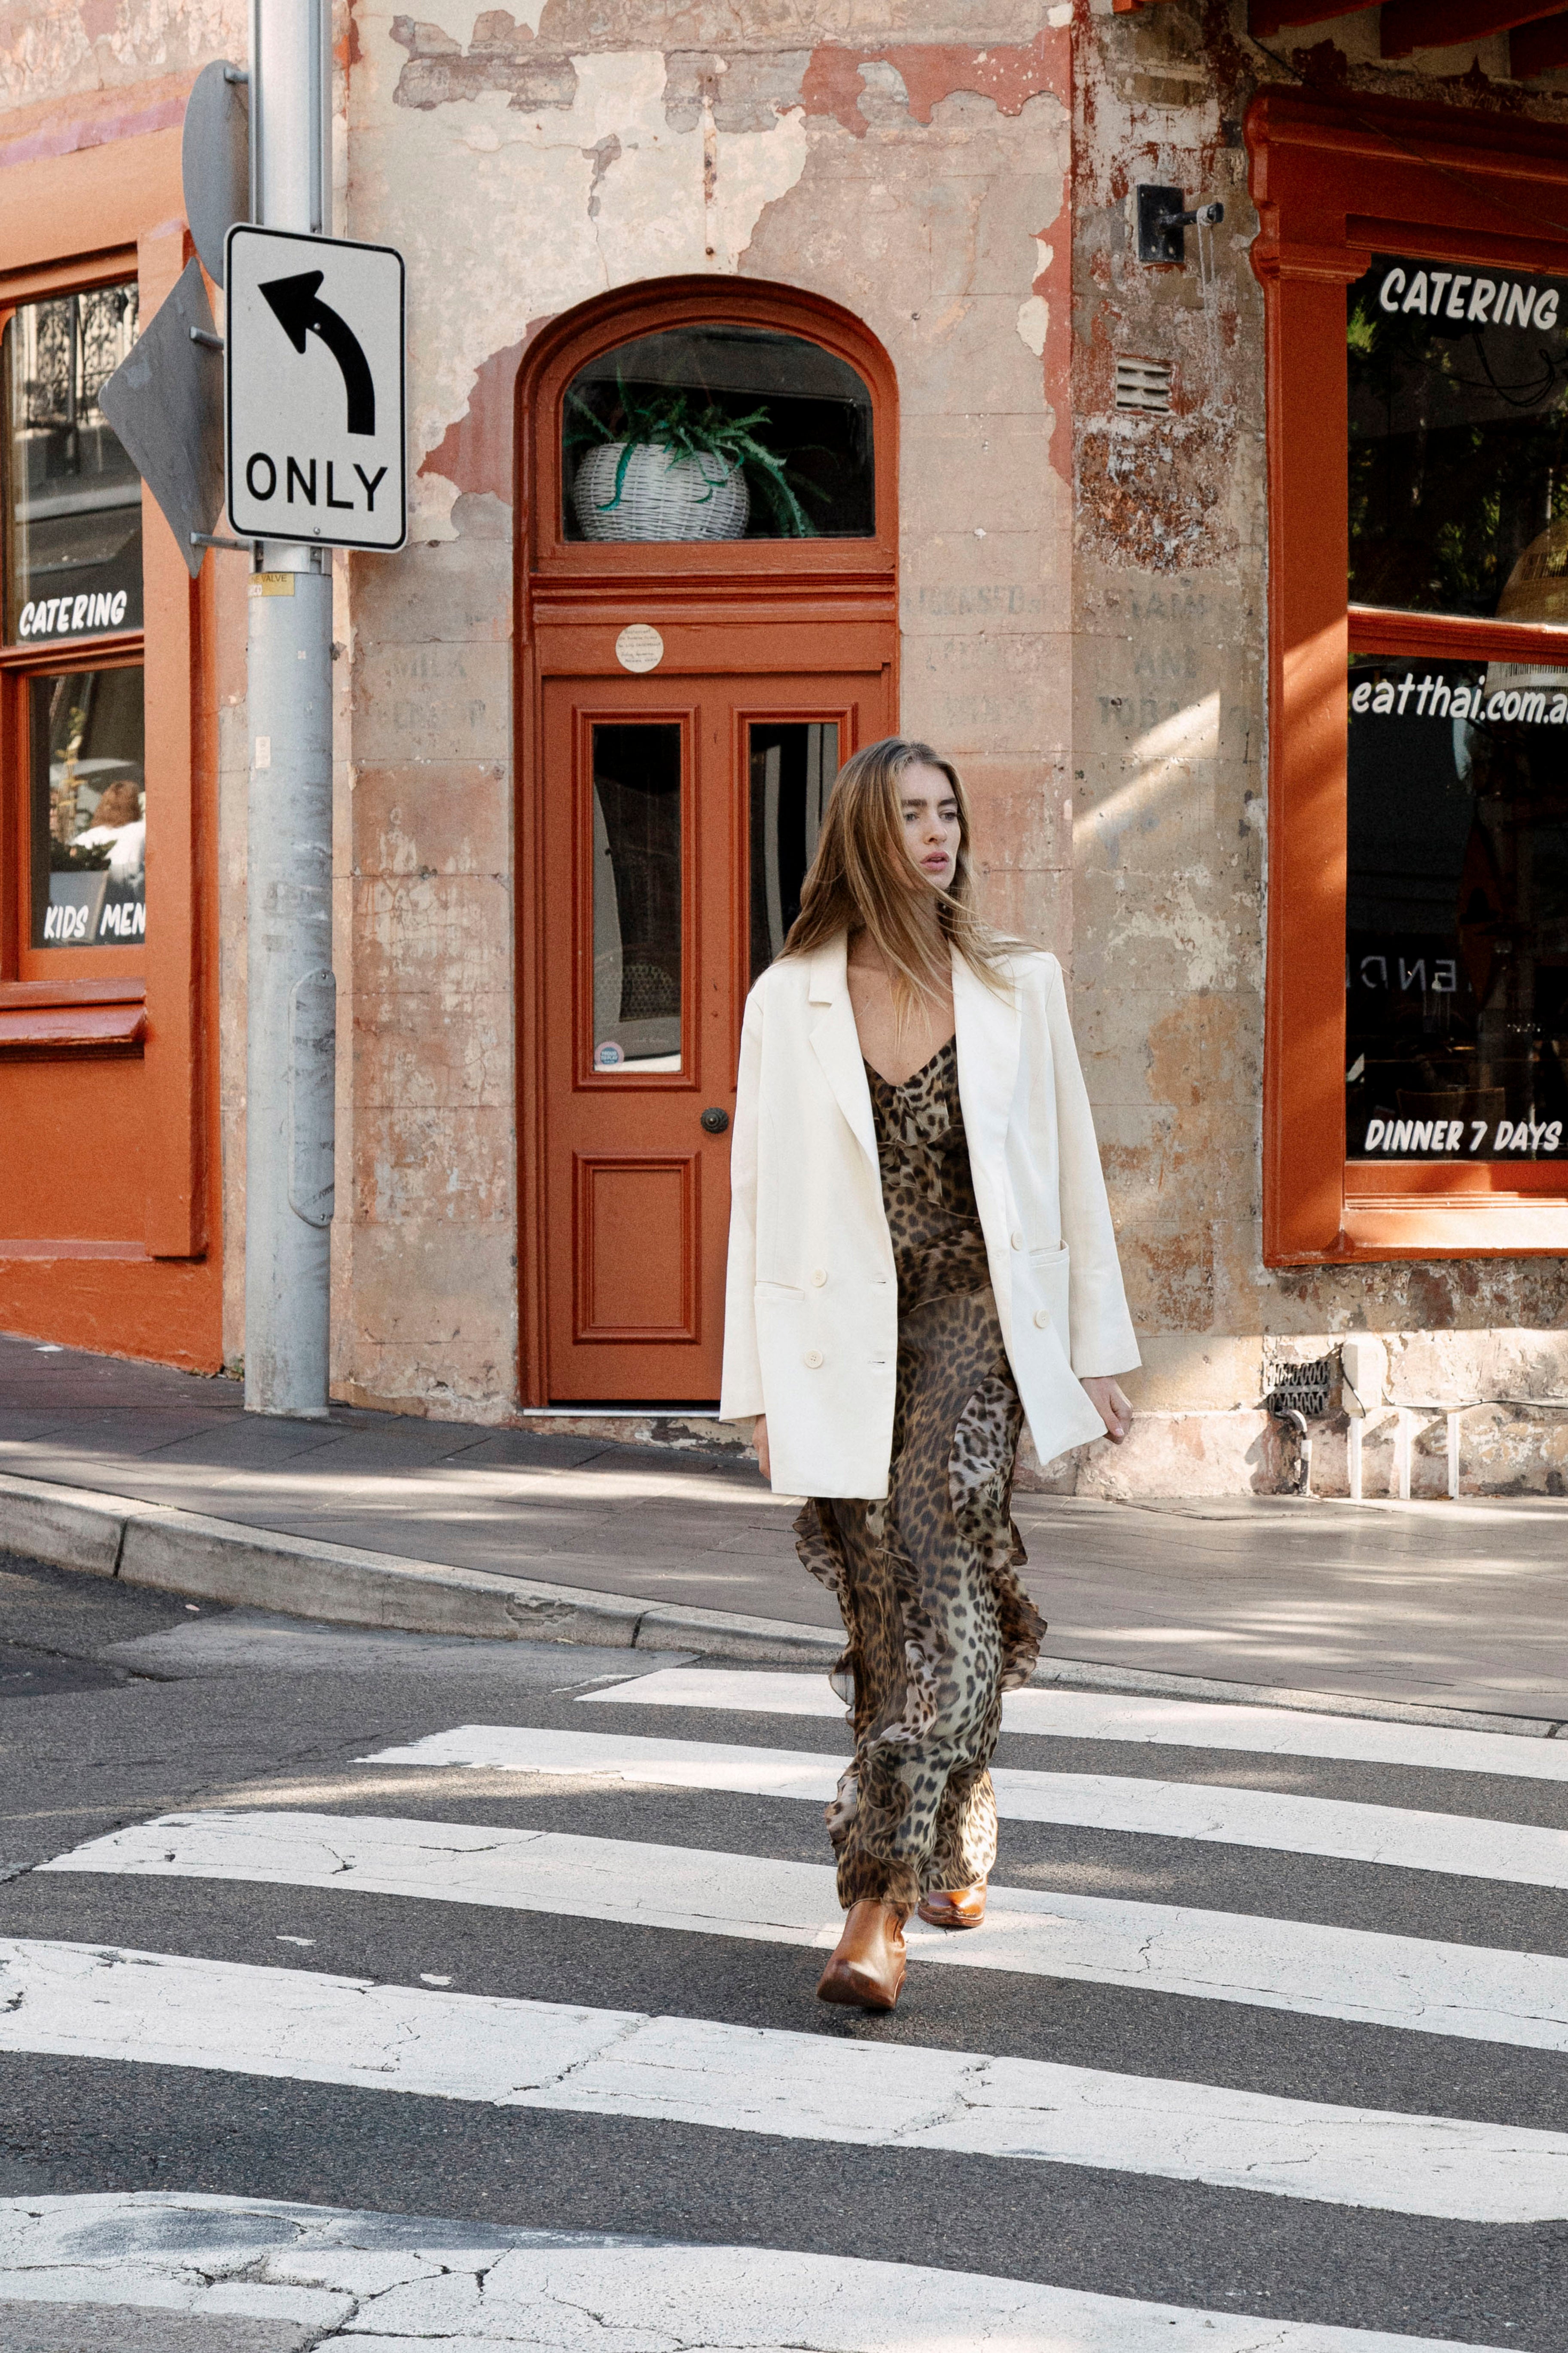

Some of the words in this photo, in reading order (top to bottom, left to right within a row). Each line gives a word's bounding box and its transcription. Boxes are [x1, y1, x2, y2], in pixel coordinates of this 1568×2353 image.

[1380, 267, 1560, 330] CATERING
[246, 452, 388, 512] ONLY
[261, 574, 287, 582] VALVE
[18, 590, 128, 637] CATERING
[1351, 673, 1568, 724] eatthai.com.a
[44, 904, 89, 940] KIDS
[100, 902, 146, 937] MEN
[1364, 1119, 1464, 1152] DINNER
[1469, 1120, 1488, 1152] 7
[1493, 1120, 1563, 1152] DAYS
